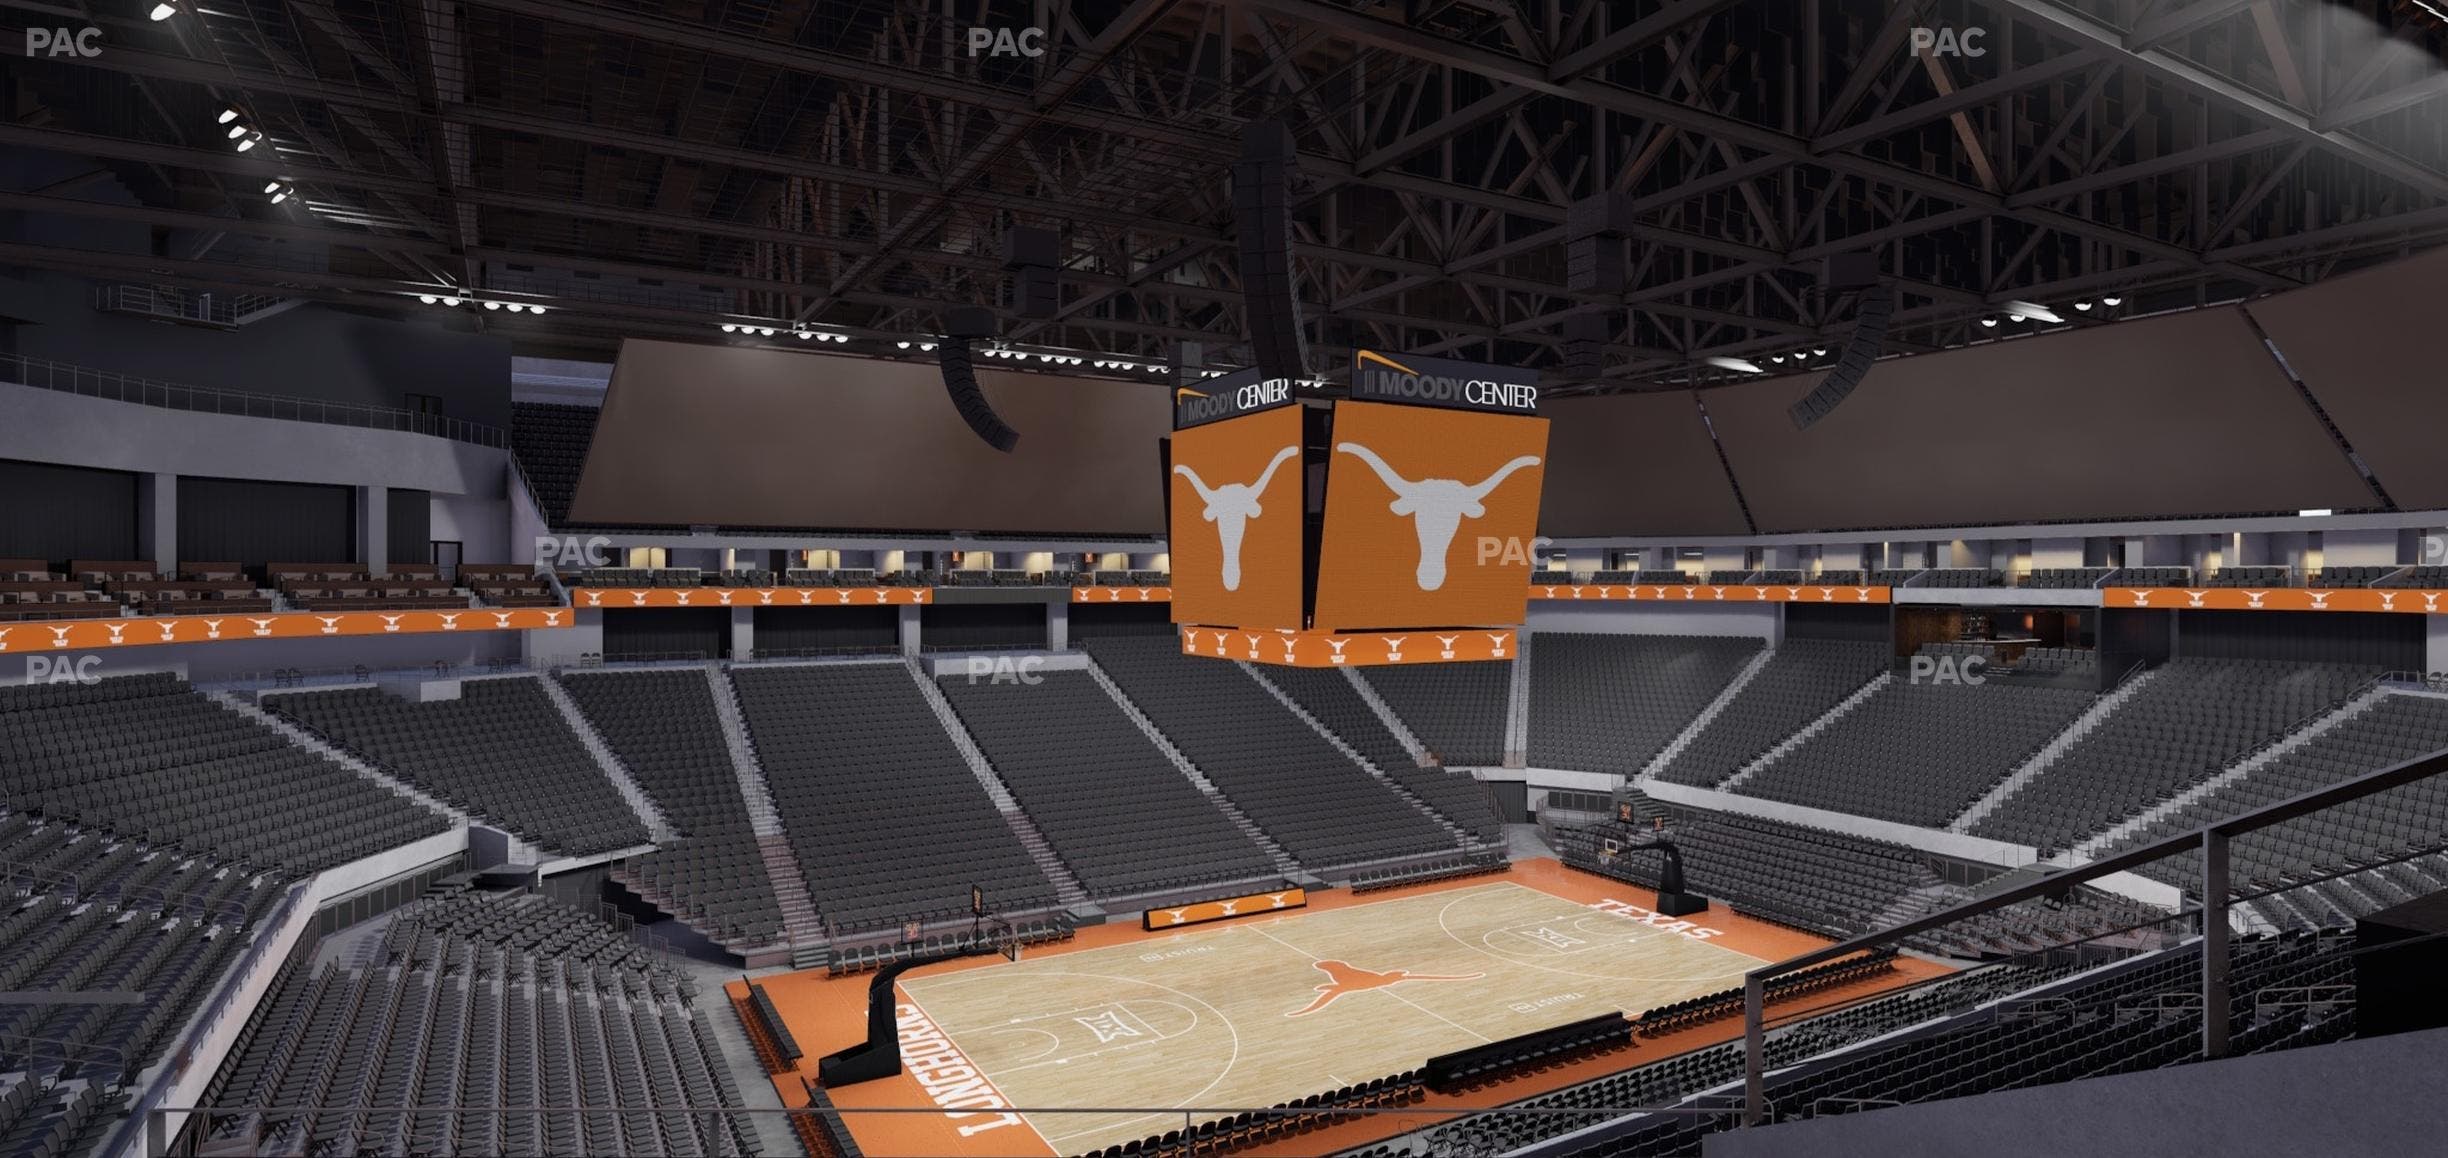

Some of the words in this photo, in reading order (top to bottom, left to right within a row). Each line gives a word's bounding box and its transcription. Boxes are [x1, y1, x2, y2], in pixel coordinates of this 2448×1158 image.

[1187, 390, 1236, 421] MOODY
[1236, 378, 1288, 410] CENTER
[1379, 370, 1464, 401] MOODY
[1465, 380, 1537, 409] CENTER
[1587, 898, 1725, 941] TEXAS
